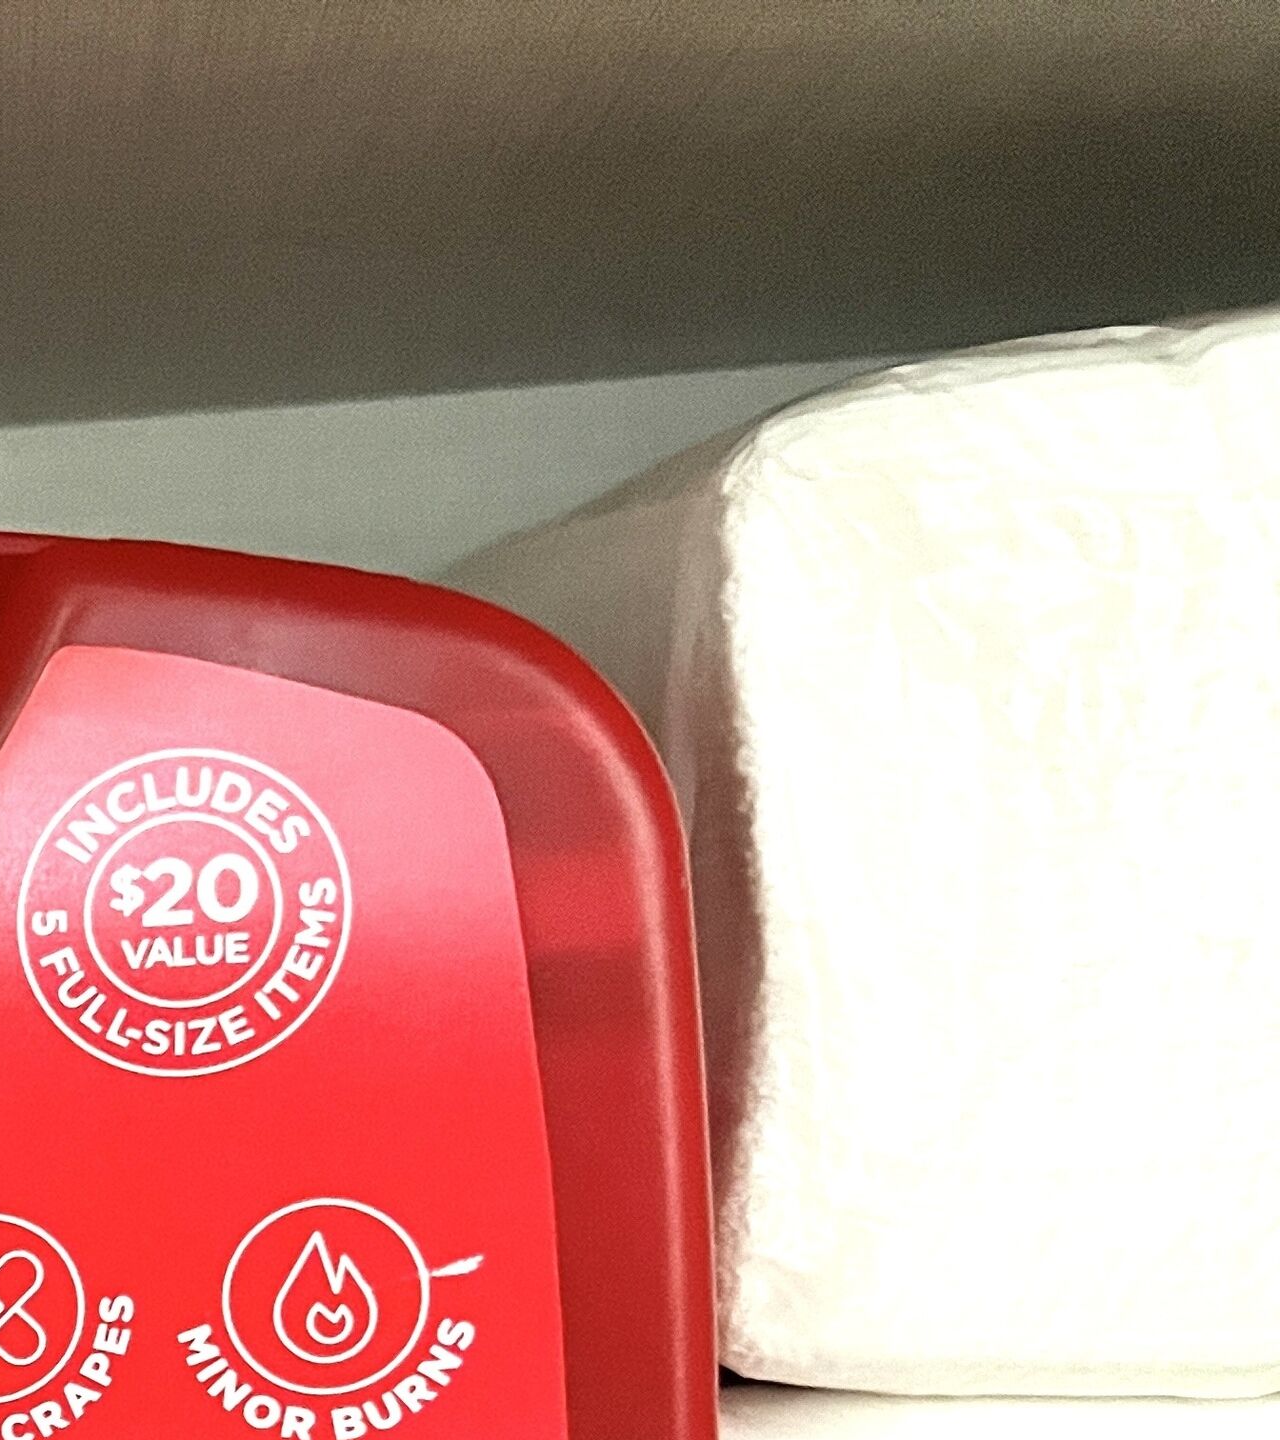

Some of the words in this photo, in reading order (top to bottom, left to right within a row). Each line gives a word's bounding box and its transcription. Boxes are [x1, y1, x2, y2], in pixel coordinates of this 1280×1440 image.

[55, 766, 312, 865] INCLUDES
[31, 908, 69, 937] 5
[109, 852, 259, 928] $20
[120, 932, 251, 970] VALUE
[253, 876, 338, 1021] ITEMS
[39, 945, 256, 1057] FULL-SIZE
